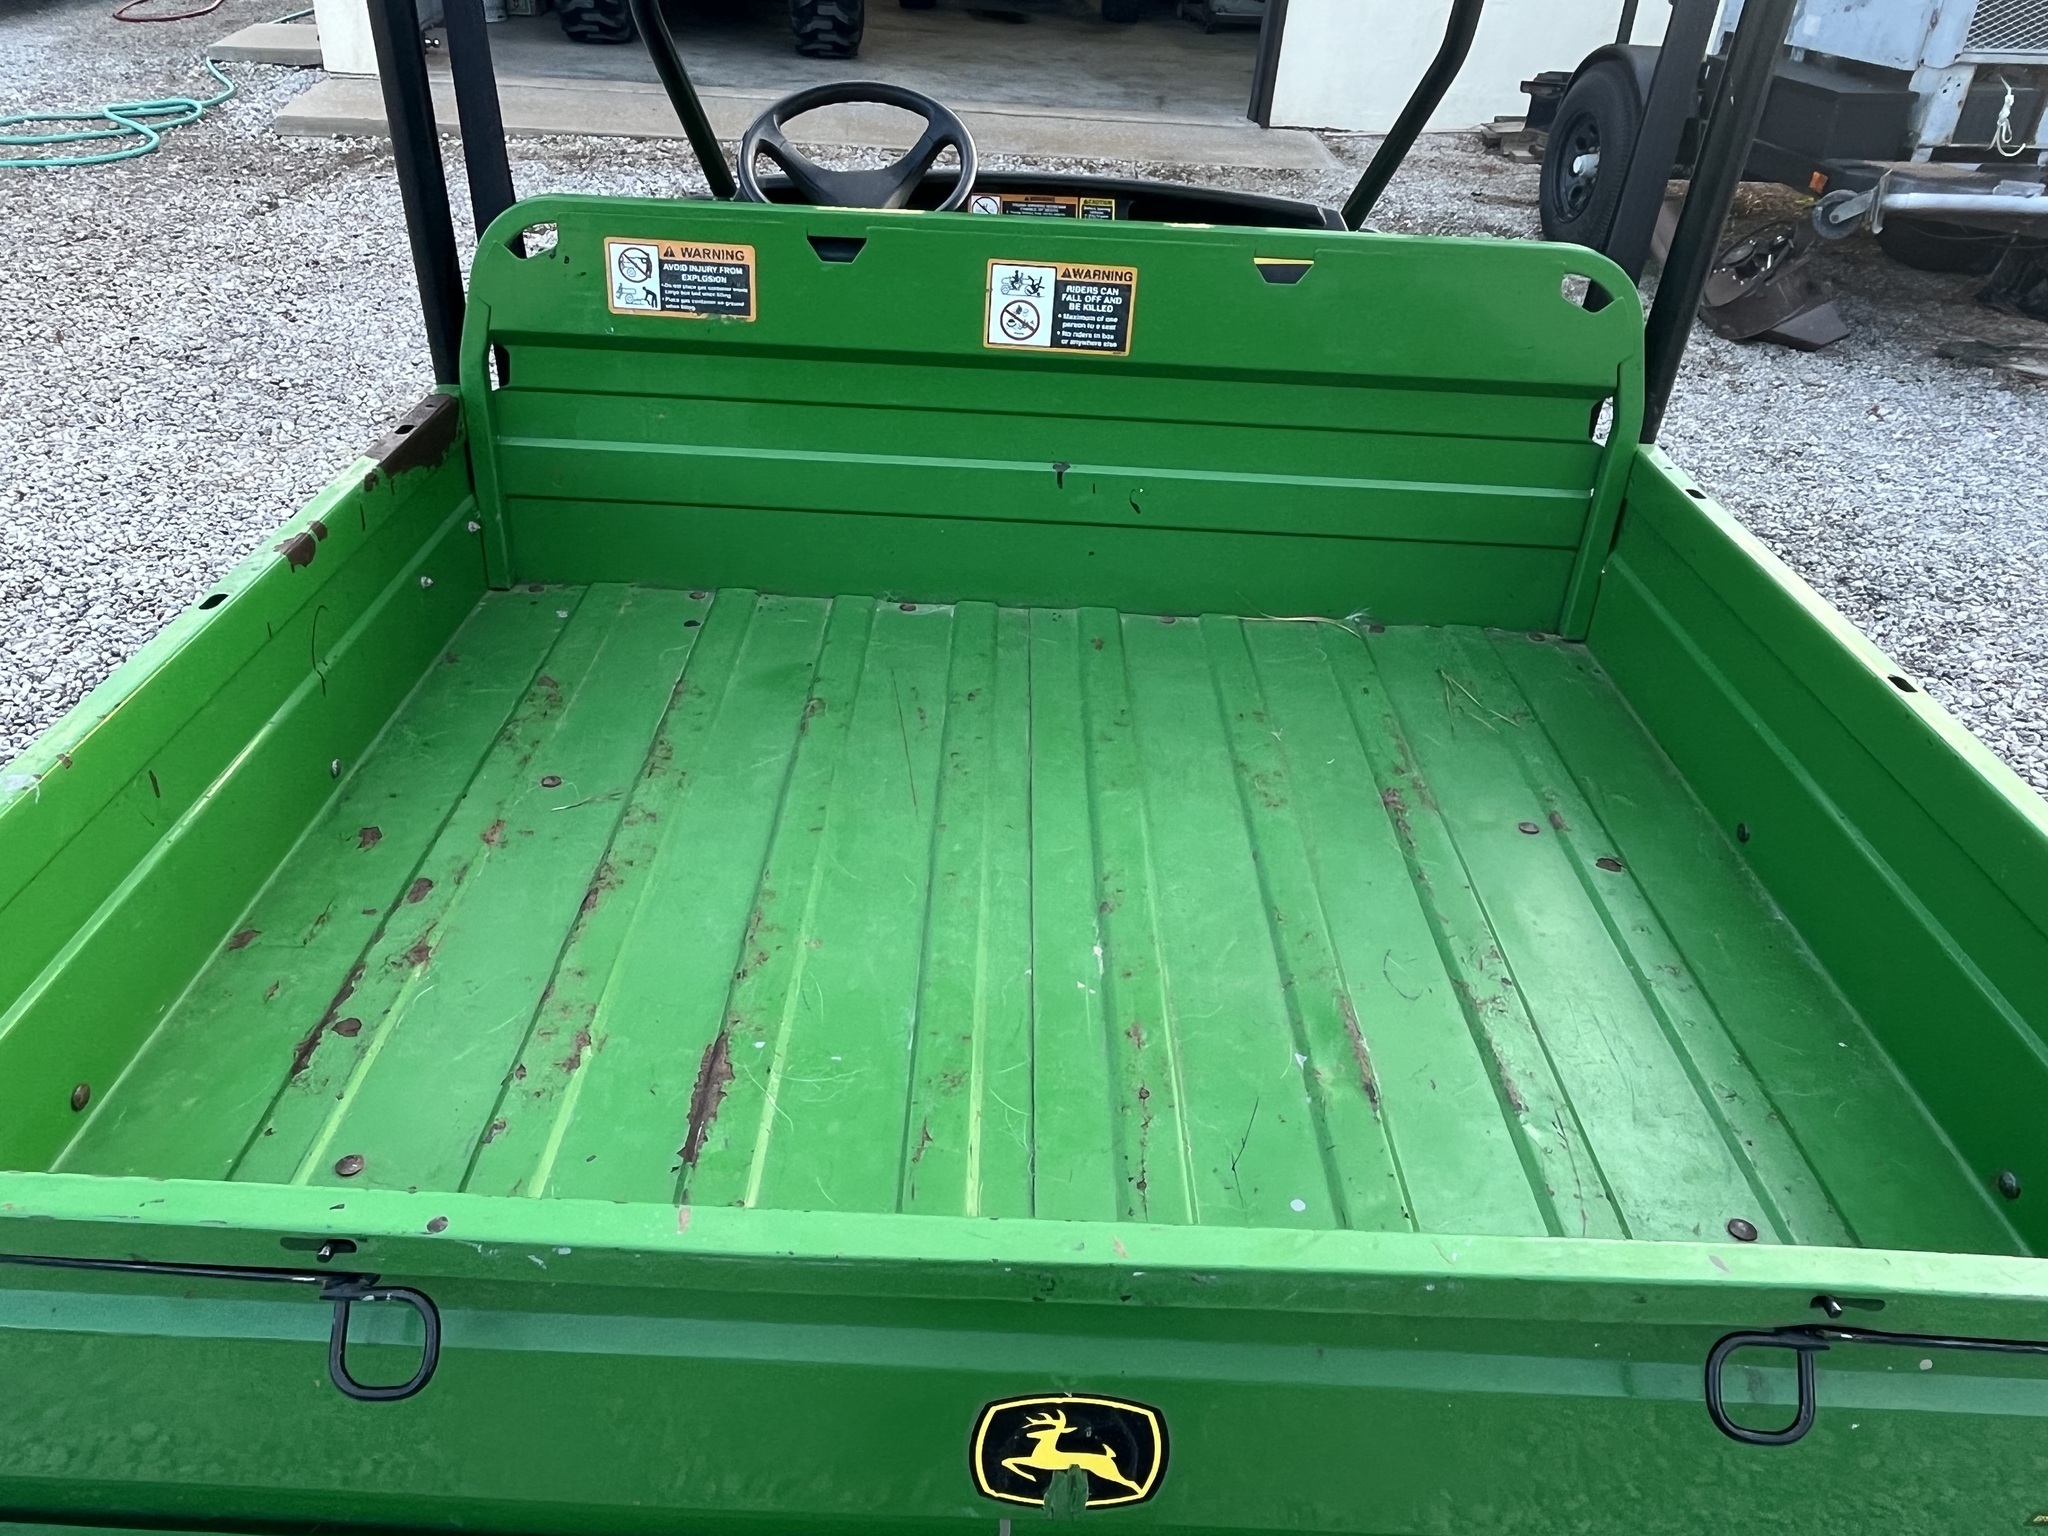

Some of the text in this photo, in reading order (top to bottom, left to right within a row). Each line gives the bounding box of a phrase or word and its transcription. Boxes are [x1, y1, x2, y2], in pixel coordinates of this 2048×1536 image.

[680, 247, 744, 261] WARNING
[663, 263, 743, 274] AVOID INJURY FROM
[682, 274, 727, 283] EXPLOSION
[1072, 268, 1133, 282] WARNING
[1066, 285, 1119, 295] RIDERS CAN
[1062, 294, 1082, 302] FALL
[1083, 304, 1113, 312] KILLED
